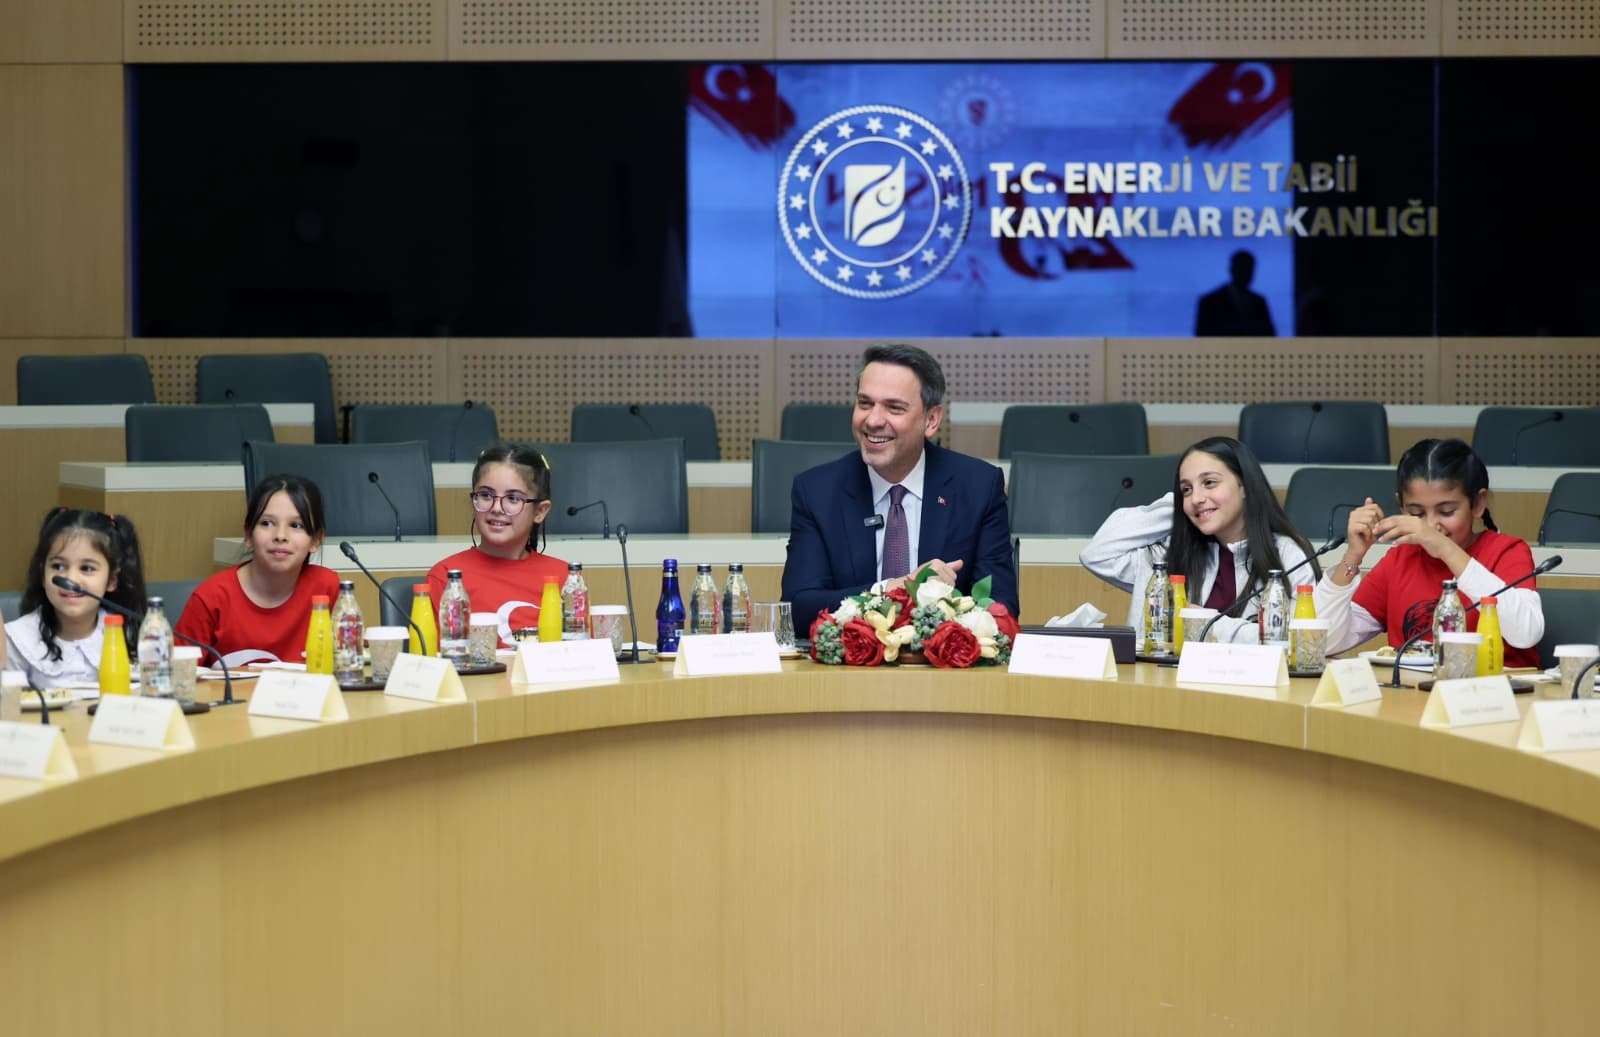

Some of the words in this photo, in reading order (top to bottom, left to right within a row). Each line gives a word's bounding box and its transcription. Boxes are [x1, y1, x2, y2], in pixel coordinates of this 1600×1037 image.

[989, 162, 1057, 194] T.C.
[1064, 156, 1192, 194] ENERJİ
[1203, 161, 1251, 193] VE
[1261, 154, 1357, 193] TABİİ
[990, 206, 1222, 239] KAYNAKLAR
[1232, 199, 1438, 238] BAKANLIĞI
